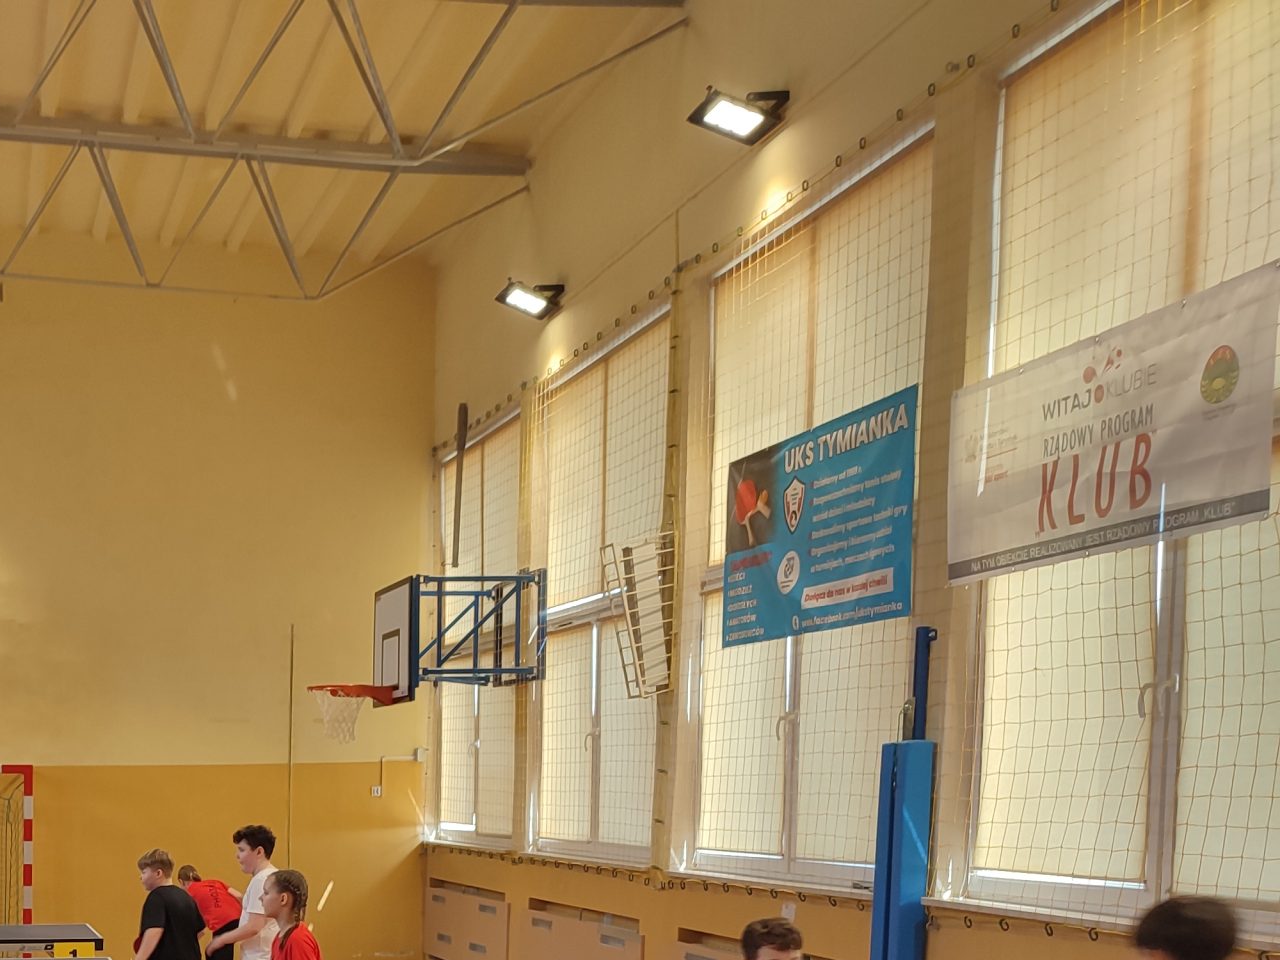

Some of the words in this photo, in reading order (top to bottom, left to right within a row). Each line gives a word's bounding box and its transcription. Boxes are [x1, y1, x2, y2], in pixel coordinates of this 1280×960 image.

[1042, 388, 1092, 422] WITAJ
[1105, 363, 1158, 398] KLUBIE
[784, 440, 814, 474] UKS
[817, 403, 909, 462] TYMIANKA
[1043, 424, 1094, 460] RZĄDOWY
[1100, 403, 1154, 441] PROGRAM
[1153, 509, 1199, 529] POGRAM
